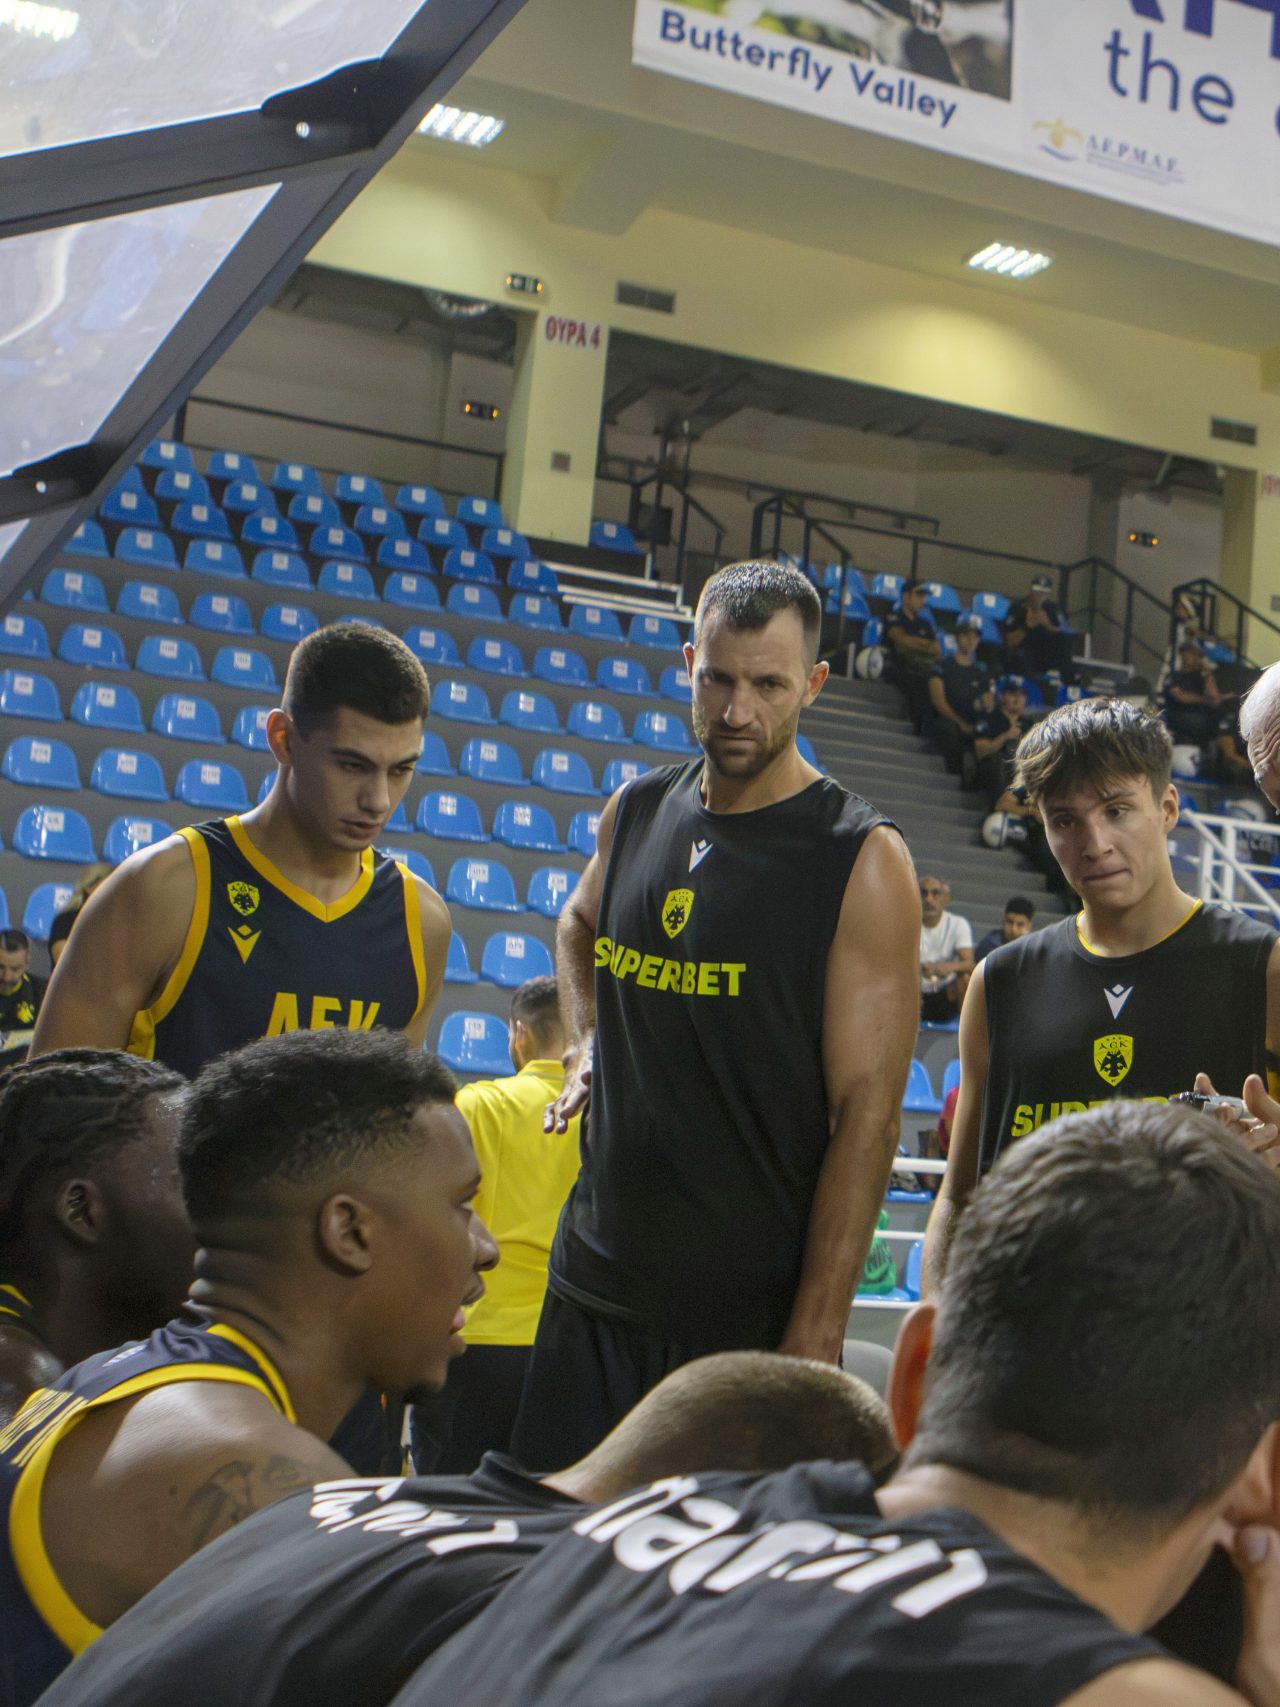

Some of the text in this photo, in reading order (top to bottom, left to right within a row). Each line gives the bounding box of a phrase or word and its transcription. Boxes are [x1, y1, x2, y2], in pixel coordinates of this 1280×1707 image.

[660, 8, 957, 128] Butterfly Valley
[1103, 29, 1234, 125] the
[590, 325, 601, 350] 4
